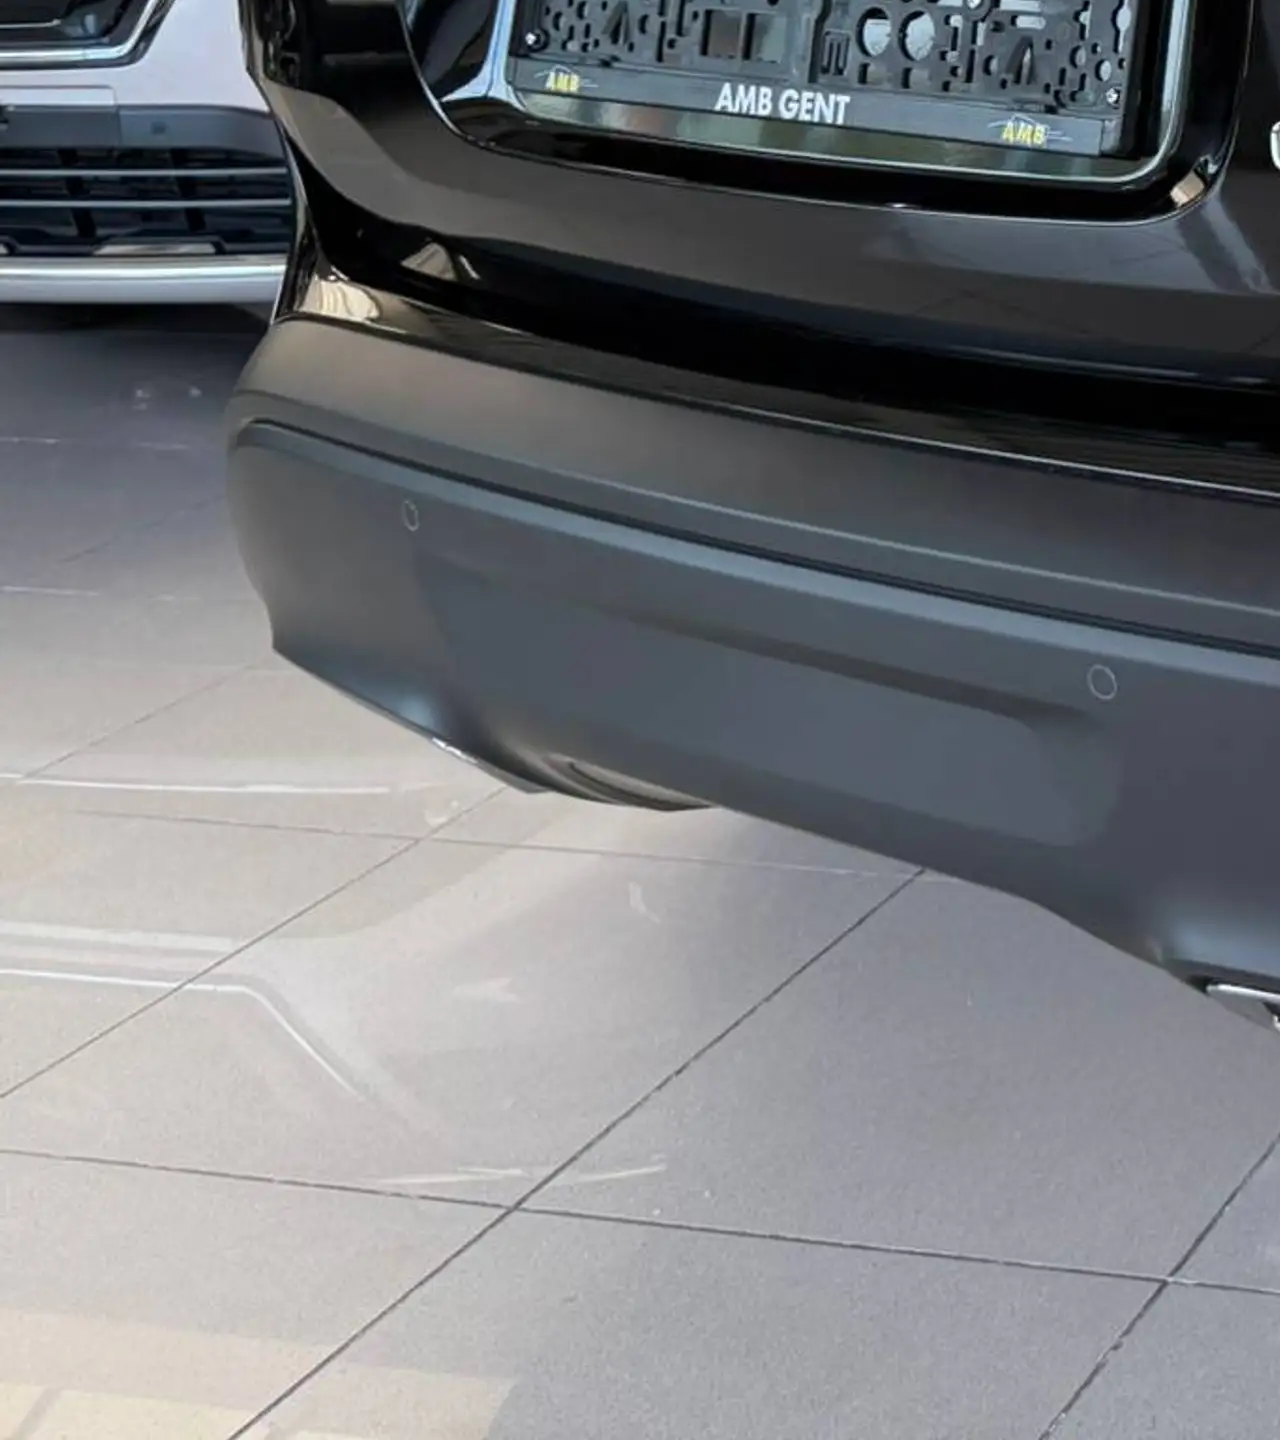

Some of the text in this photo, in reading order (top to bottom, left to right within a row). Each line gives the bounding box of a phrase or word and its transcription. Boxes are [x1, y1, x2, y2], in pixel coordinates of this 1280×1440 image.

[545, 71, 579, 93] AMB
[714, 82, 851, 126] AMB GENT
[1001, 120, 1050, 148] AMB
